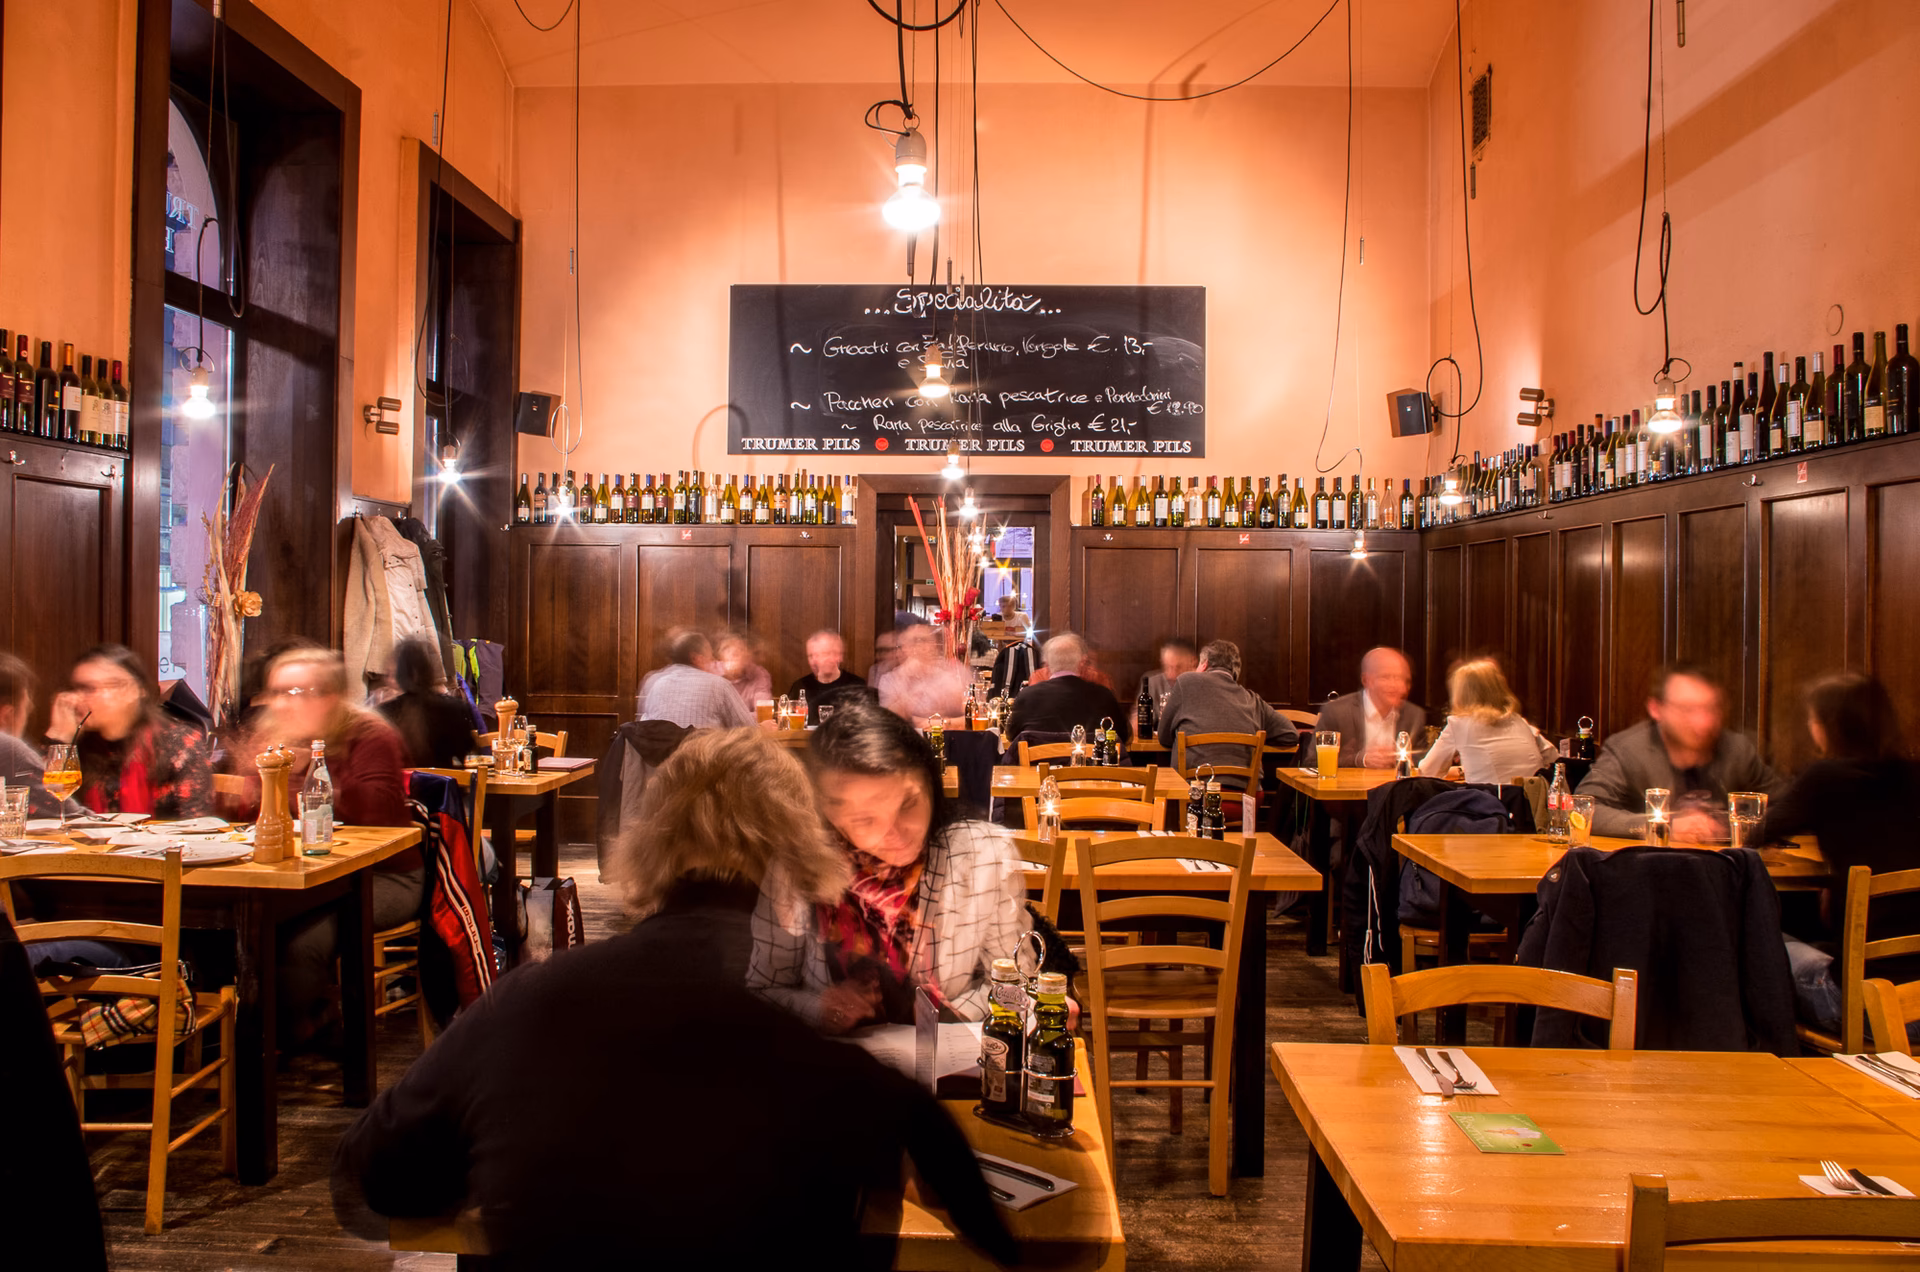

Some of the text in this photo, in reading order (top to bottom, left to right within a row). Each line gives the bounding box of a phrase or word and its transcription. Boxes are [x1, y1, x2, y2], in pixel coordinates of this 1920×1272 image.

[896, 341, 920, 353] con
[897, 358, 910, 369] e
[823, 391, 895, 413] Paccheri
[998, 387, 1090, 409] pescatrice
[872, 413, 913, 436] Rana
[992, 417, 1022, 433] alla
[1031, 413, 1081, 437] Griglia
[1087, 413, 1107, 432] €
[741, 437, 818, 451] TRUMER
[822, 437, 861, 451] PILS
[986, 438, 1025, 452] PILS
[1070, 439, 1149, 453] TRUMER
[1153, 439, 1192, 453] PILS
